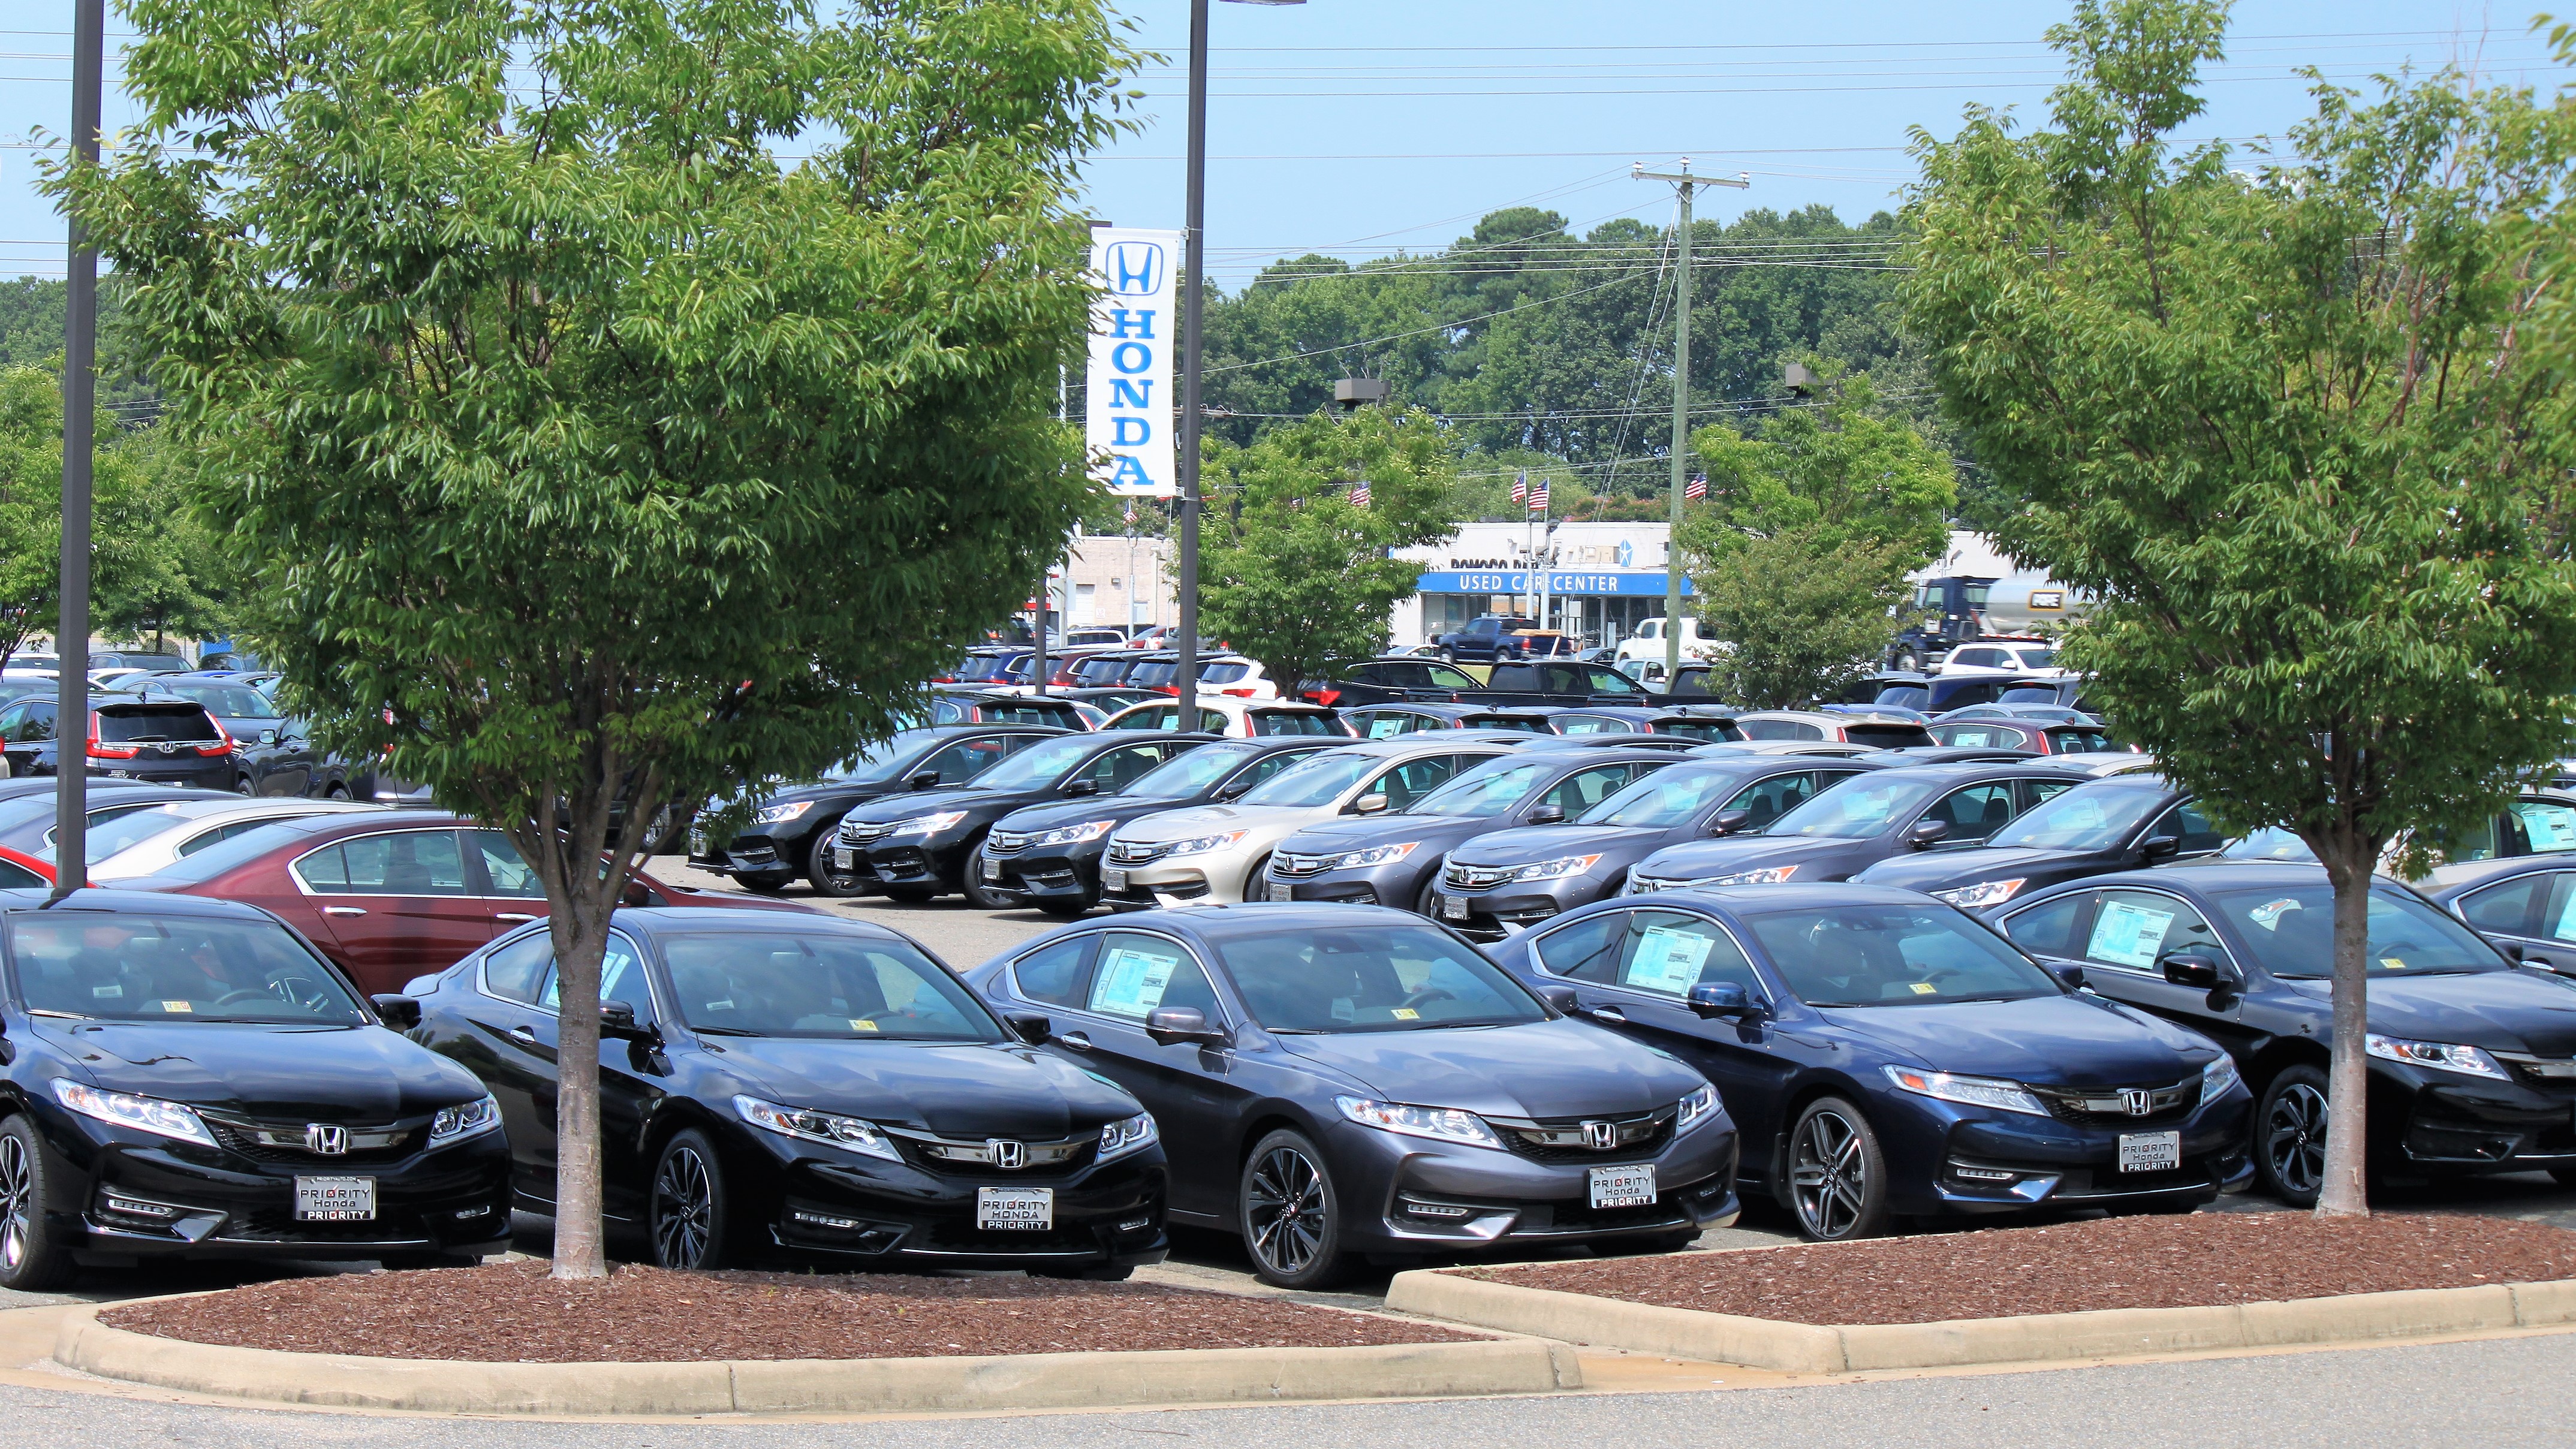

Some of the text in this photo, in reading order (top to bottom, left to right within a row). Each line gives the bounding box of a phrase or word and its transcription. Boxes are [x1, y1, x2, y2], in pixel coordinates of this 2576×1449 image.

[1108, 309, 1156, 485] HONDA
[1460, 574, 1502, 590] USED
[1553, 576, 1617, 591] CENTER
[2123, 1143, 2175, 1153] PRIORITY
[2133, 1152, 2165, 1161] Honda
[2128, 1161, 2171, 1171] PRIORITY
[1593, 1176, 1650, 1188] PRIORITY
[300, 1189, 370, 1198] PRIORITY
[1605, 1187, 1640, 1195] Honda
[314, 1198, 355, 1207] Honda
[982, 1200, 1048, 1210] PRIORITY
[1601, 1196, 1648, 1207] PRIORITY
[308, 1211, 365, 1219] PRIORITY
[992, 1210, 1038, 1219] HONDA
